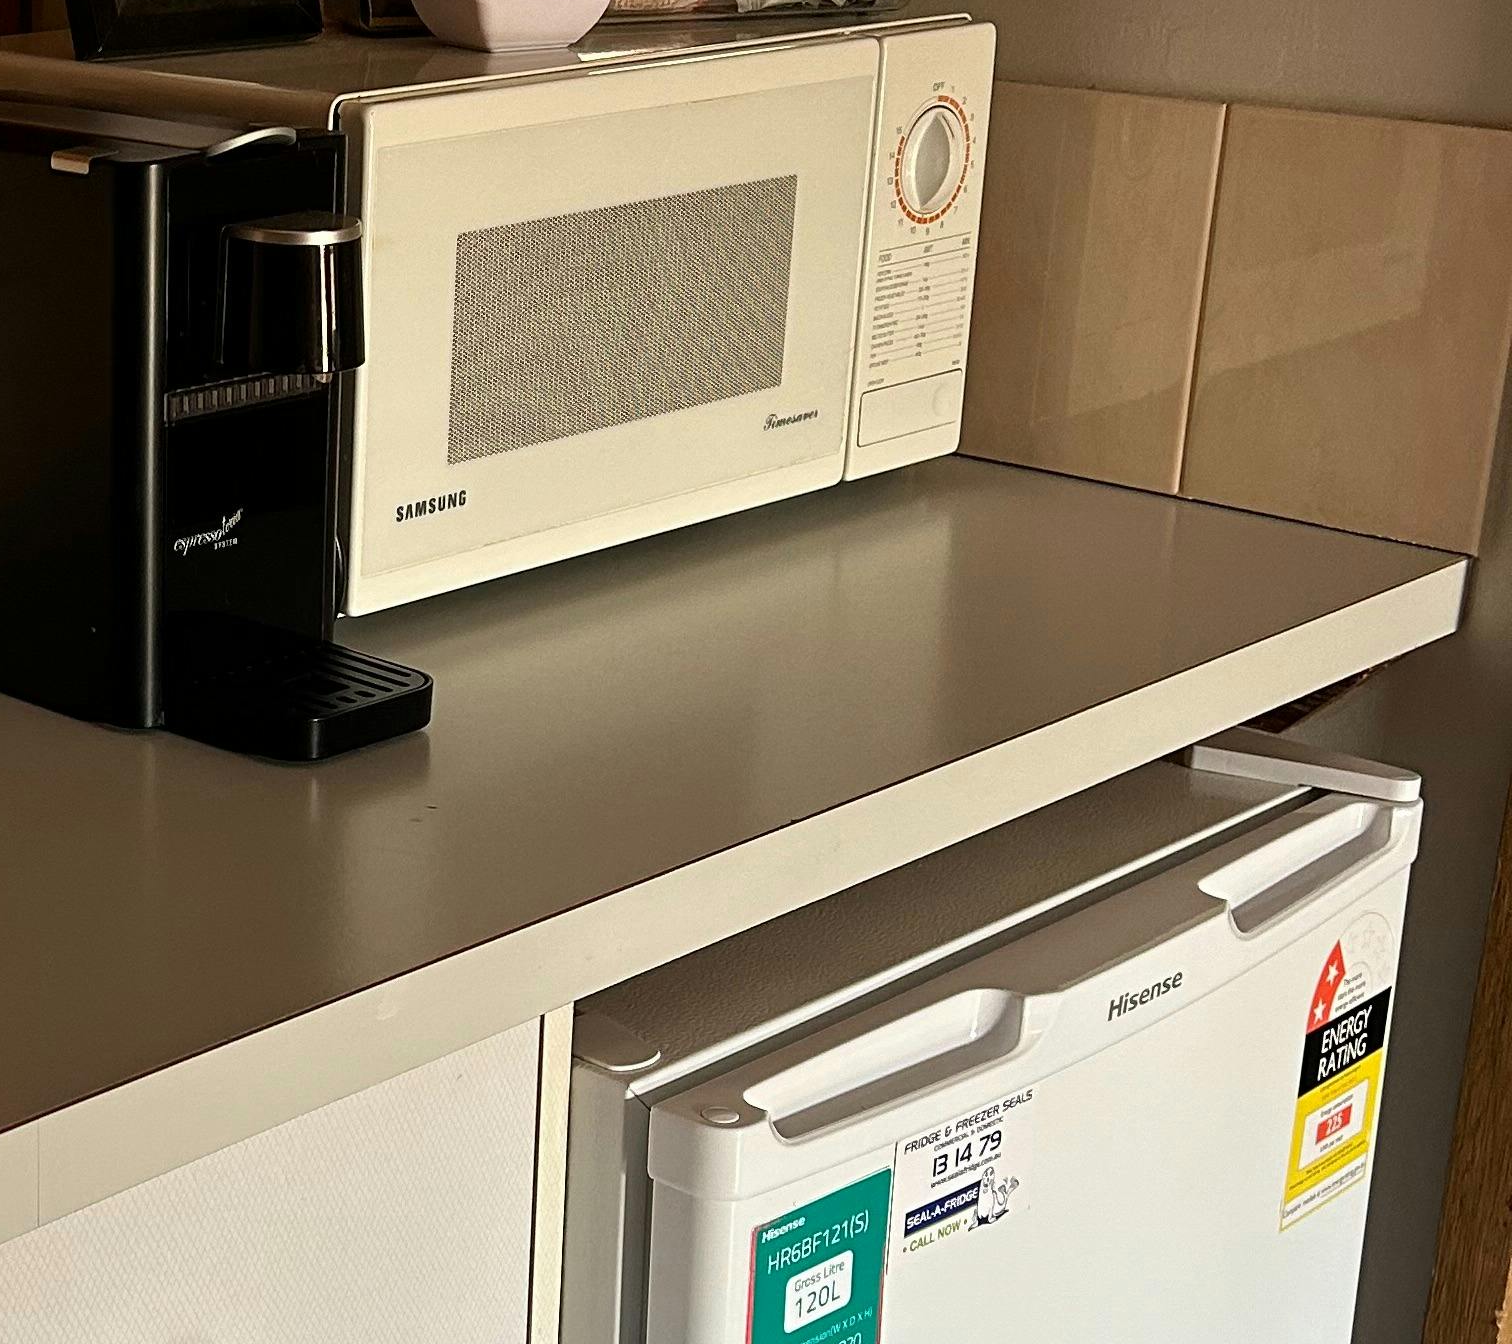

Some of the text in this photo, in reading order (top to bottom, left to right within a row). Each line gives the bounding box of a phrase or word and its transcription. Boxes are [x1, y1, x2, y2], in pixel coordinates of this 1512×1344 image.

[764, 409, 818, 431] Timesaver
[396, 489, 467, 522] SAMSUNG
[1107, 971, 1183, 1022] Hisense
[1321, 1005, 1372, 1053] ENERGY
[1317, 1033, 1368, 1081] RATING
[904, 1089, 1033, 1155] FRIDGE & FREEZER SEALS
[977, 1116, 1004, 1134] DOMESTIC
[933, 1130, 1002, 1177] 13 14 79
[906, 1187, 979, 1229] SEAL-A-FRIDGE
[762, 1217, 805, 1243] Hisense
[768, 1209, 868, 1274] HR6BF121(S)
[909, 1219, 962, 1252] CALL NOW
[794, 1261, 845, 1292] Gross Litre
[795, 1280, 840, 1318] 120L
